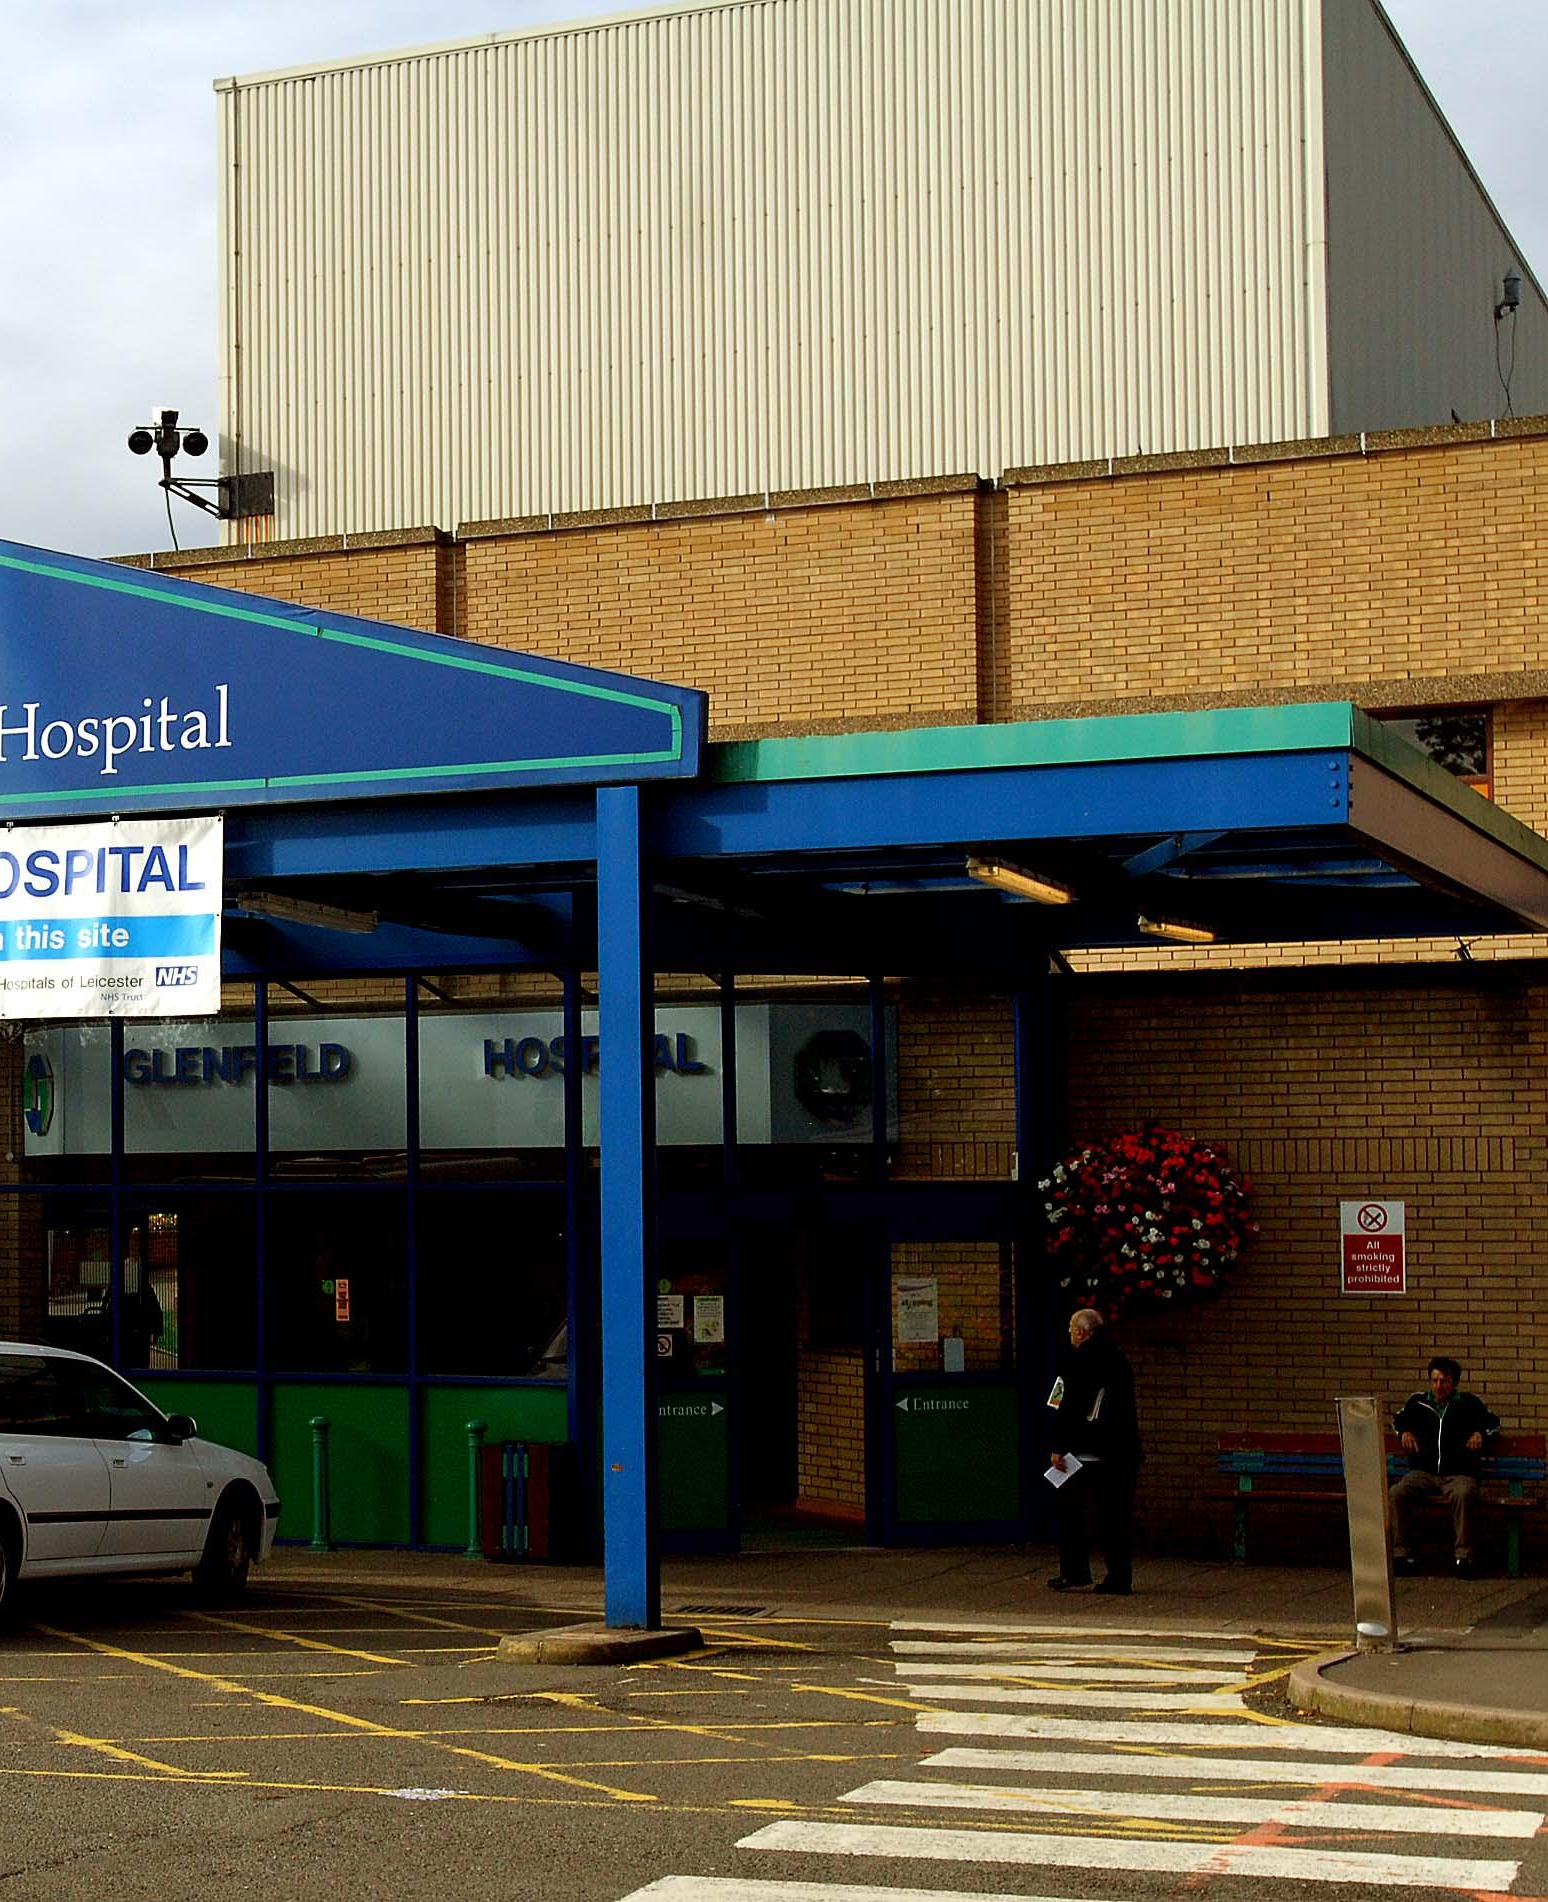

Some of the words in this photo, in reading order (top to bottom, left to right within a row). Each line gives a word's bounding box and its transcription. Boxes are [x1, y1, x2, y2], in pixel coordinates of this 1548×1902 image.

[16, 924, 65, 950] this
[77, 922, 130, 948] site
[61, 976, 75, 988] of
[80, 975, 145, 988] Leicester
[156, 966, 198, 986] NHS
[101, 993, 120, 1001] NHS
[122, 992, 144, 1001] Trust
[124, 1043, 351, 1084] GLENFELD
[484, 1032, 709, 1075] HOSPAL
[1366, 1240, 1380, 1249] All
[1351, 1252, 1395, 1263] smoking
[1356, 1263, 1391, 1274] strictly
[1347, 1274, 1400, 1284] prohibited
[658, 1404, 707, 1417] ntrance
[913, 1397, 970, 1411] Entrance
